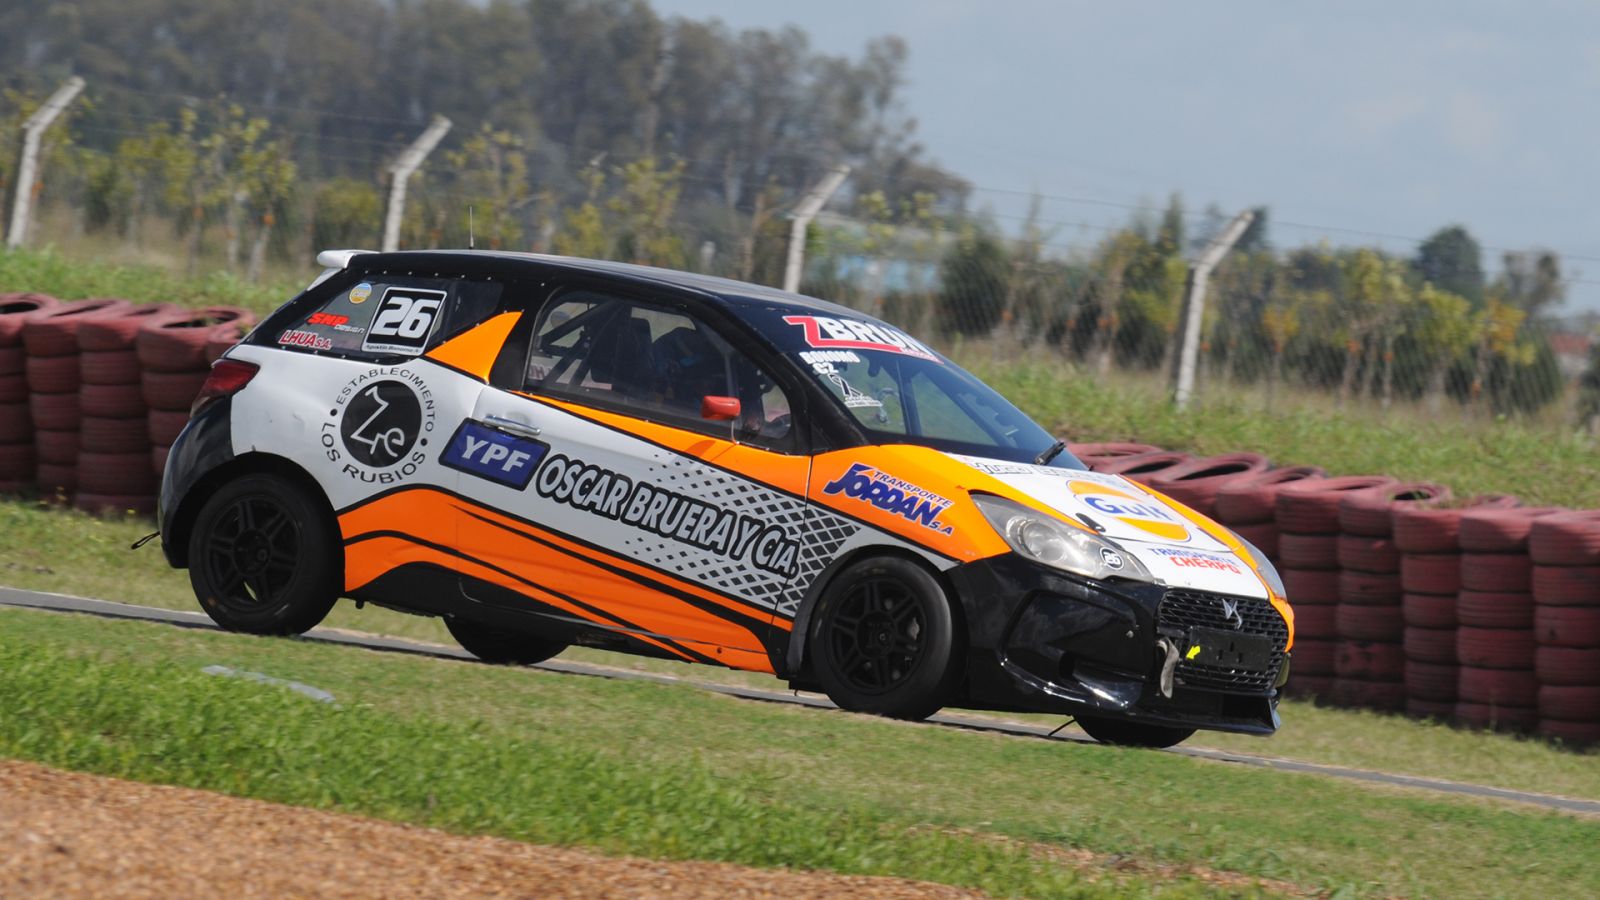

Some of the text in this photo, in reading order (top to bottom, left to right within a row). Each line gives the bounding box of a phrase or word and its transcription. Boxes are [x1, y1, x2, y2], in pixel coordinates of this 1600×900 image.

[371, 296, 440, 339] 26
[813, 362, 839, 374] C2
[336, 367, 435, 432] ESTABLECIMIENTO
[321, 422, 426, 484] LOS RUBIOS
[461, 435, 531, 473] YPF
[537, 455, 632, 518] OSCAR
[622, 483, 737, 555] BRUERA
[730, 517, 763, 560] Y
[822, 462, 944, 527] JORDAN
[873, 470, 954, 507] TRANSPORTE
[1084, 496, 1174, 522] Gulf
[1103, 551, 1121, 565] 26
